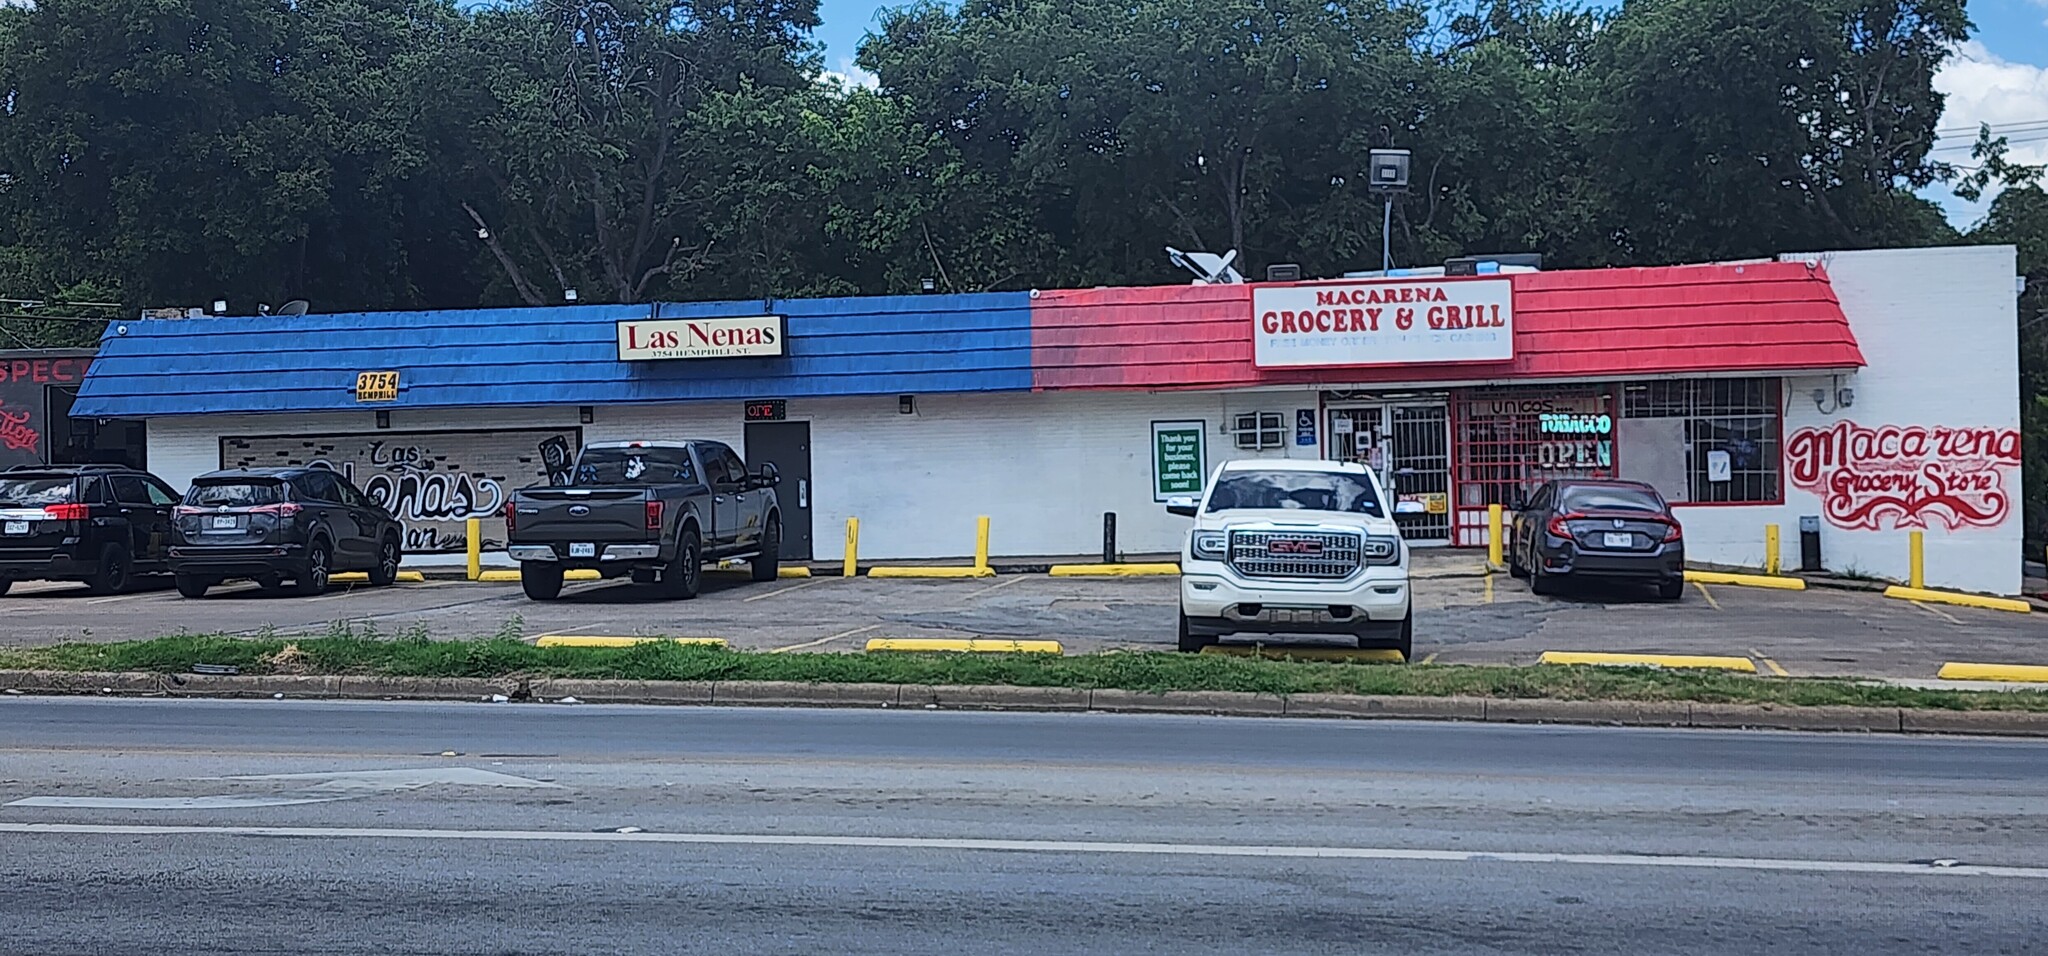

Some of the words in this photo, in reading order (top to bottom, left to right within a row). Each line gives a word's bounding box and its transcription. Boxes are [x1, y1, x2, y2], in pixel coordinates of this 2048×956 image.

[1316, 287, 1448, 306] MACARENA
[1262, 308, 1382, 334] GROCERY
[1396, 307, 1413, 331] &
[1427, 304, 1505, 329] GRILL
[626, 324, 679, 350] Las
[686, 322, 775, 348] Nenas
[651, 350, 672, 358] 3754
[675, 348, 734, 357] HEMPHILL
[359, 373, 397, 390] 3754
[358, 391, 396, 400] HEMPHILL
[1539, 413, 1611, 434] TOBACCO
[1160, 433, 1182, 443] Thank
[1182, 435, 1197, 444] you
[1177, 444, 1194, 454] your
[1539, 440, 1611, 467] OPEN
[1787, 421, 2021, 482] Macarena
[1168, 462, 1191, 472] please
[1181, 470, 1198, 479] back
[1831, 467, 1923, 509] Grocery
[1923, 463, 1991, 498] Store
[400, 521, 444, 549] ar
[1270, 541, 1320, 553] GMC
